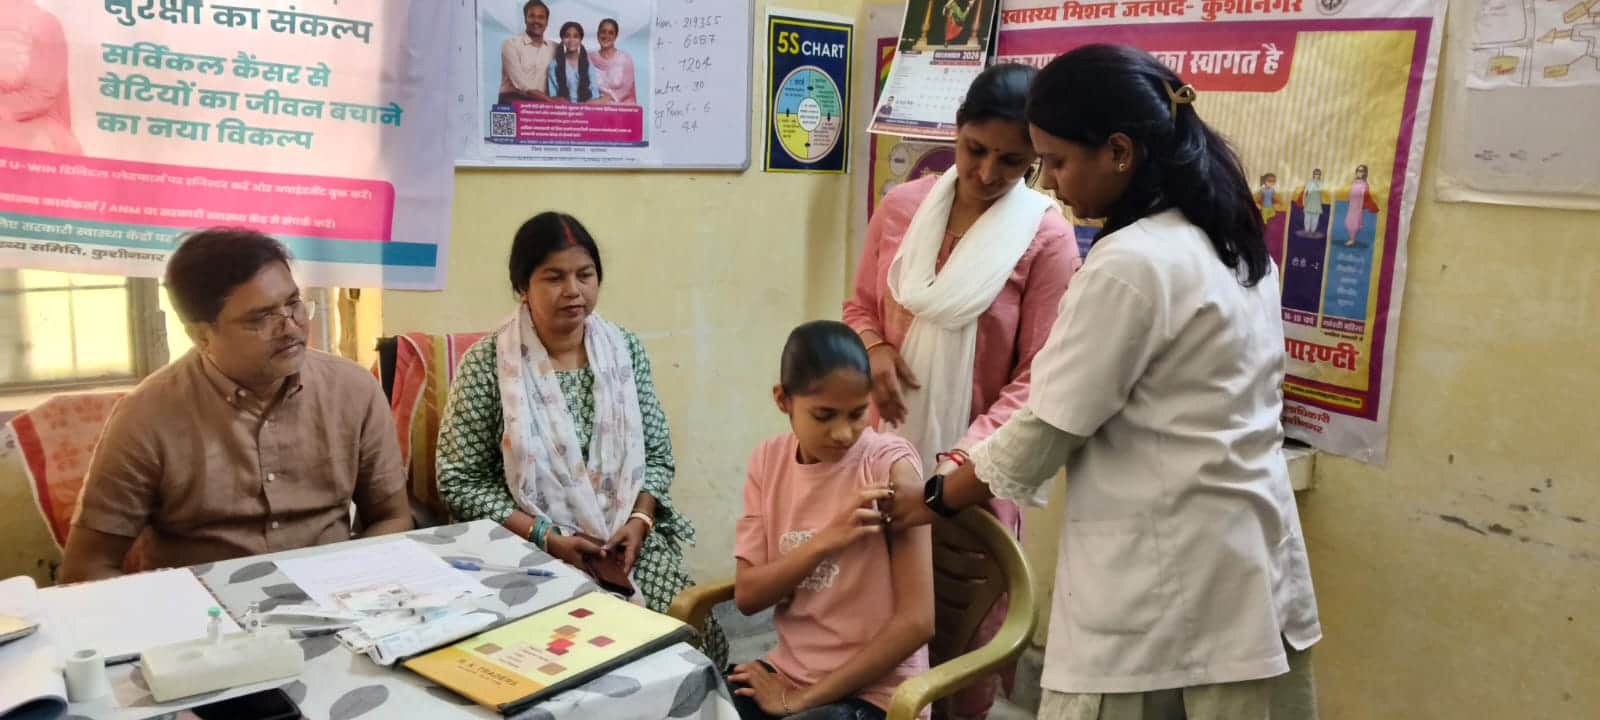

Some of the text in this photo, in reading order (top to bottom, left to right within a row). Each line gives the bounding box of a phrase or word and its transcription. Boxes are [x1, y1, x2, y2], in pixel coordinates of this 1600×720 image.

[211, 4, 260, 29] का
[268, 6, 373, 43] संकल्प
[1062, 0, 1116, 20] मिशन
[101, 41, 331, 87] सर्विकल कैंसर से
[777, 31, 845, 59] 5S CHART
[1188, 50, 1261, 75] स्वागत
[1262, 43, 1284, 75] है
[98, 72, 403, 127] बेटियों का जीवन बचाने
[96, 111, 313, 149] का नया विकल्प
